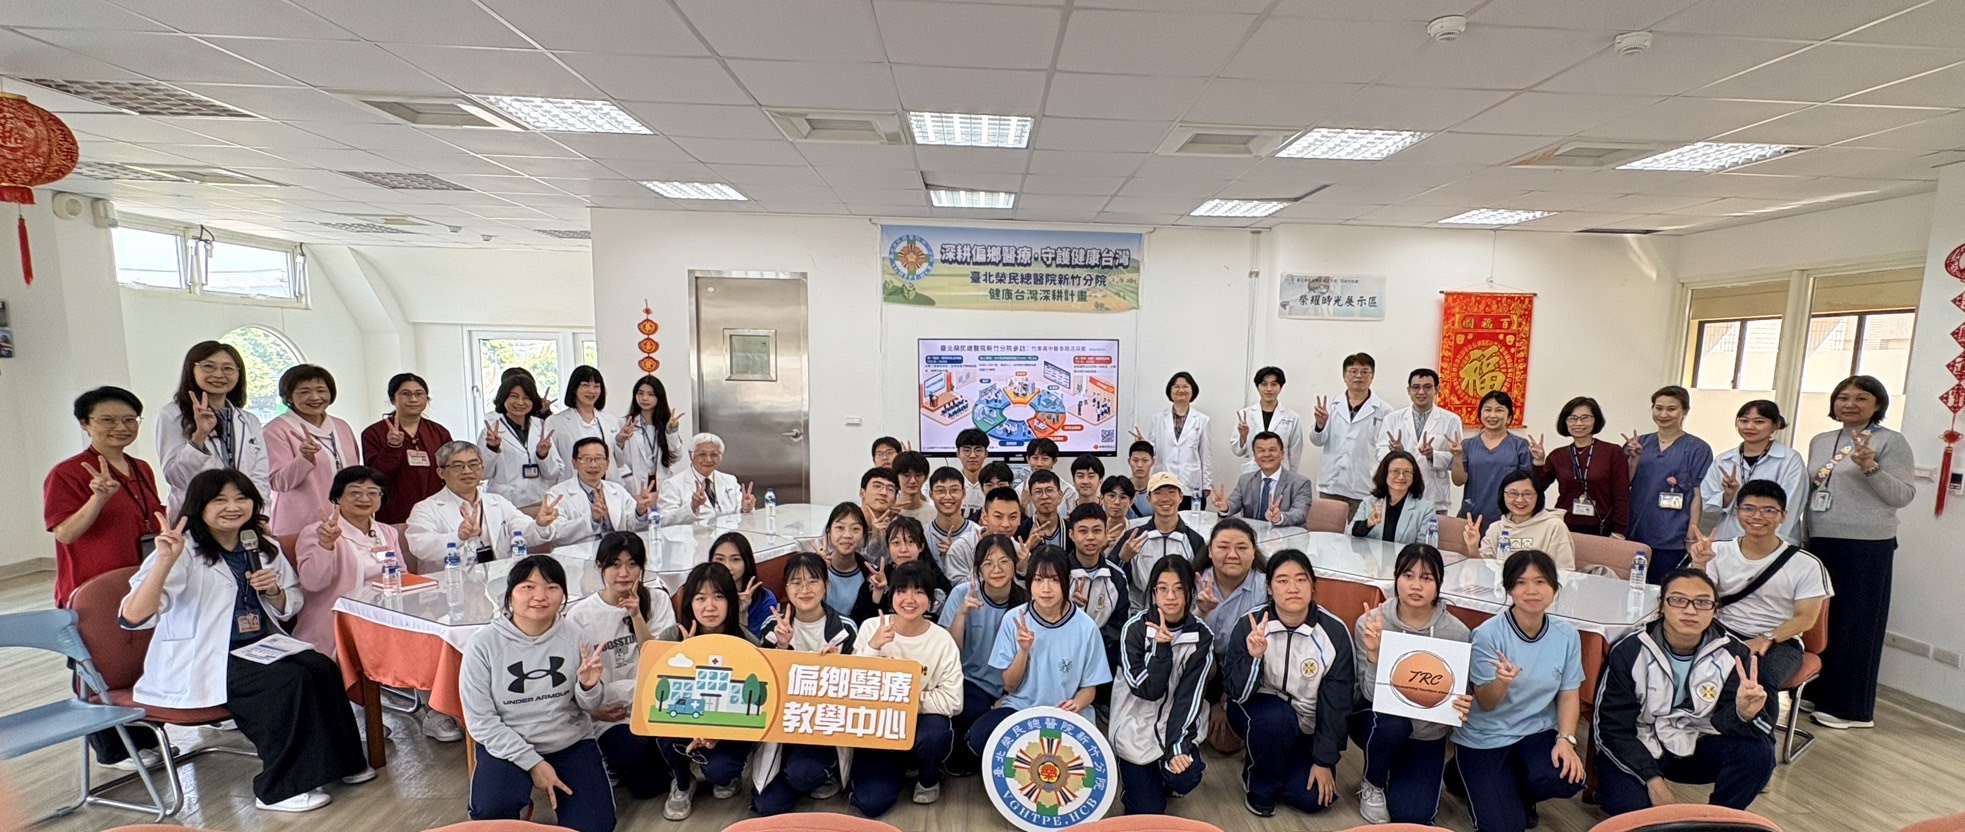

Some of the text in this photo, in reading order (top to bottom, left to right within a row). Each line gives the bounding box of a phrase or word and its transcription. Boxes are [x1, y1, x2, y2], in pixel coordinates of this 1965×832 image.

[970, 271, 1107, 287] 臺北榮民總醫院新竹分院
[988, 288, 1089, 302] 健康台灣深耕計畫
[1299, 294, 1378, 307] 榮耀時光展示區
[1459, 345, 1506, 398] 福
[787, 663, 913, 703] 偏鄉醫療
[1408, 670, 1444, 686] TRC
[503, 689, 570, 705] UNDER ARMOUR
[782, 701, 907, 740] 教學中心
